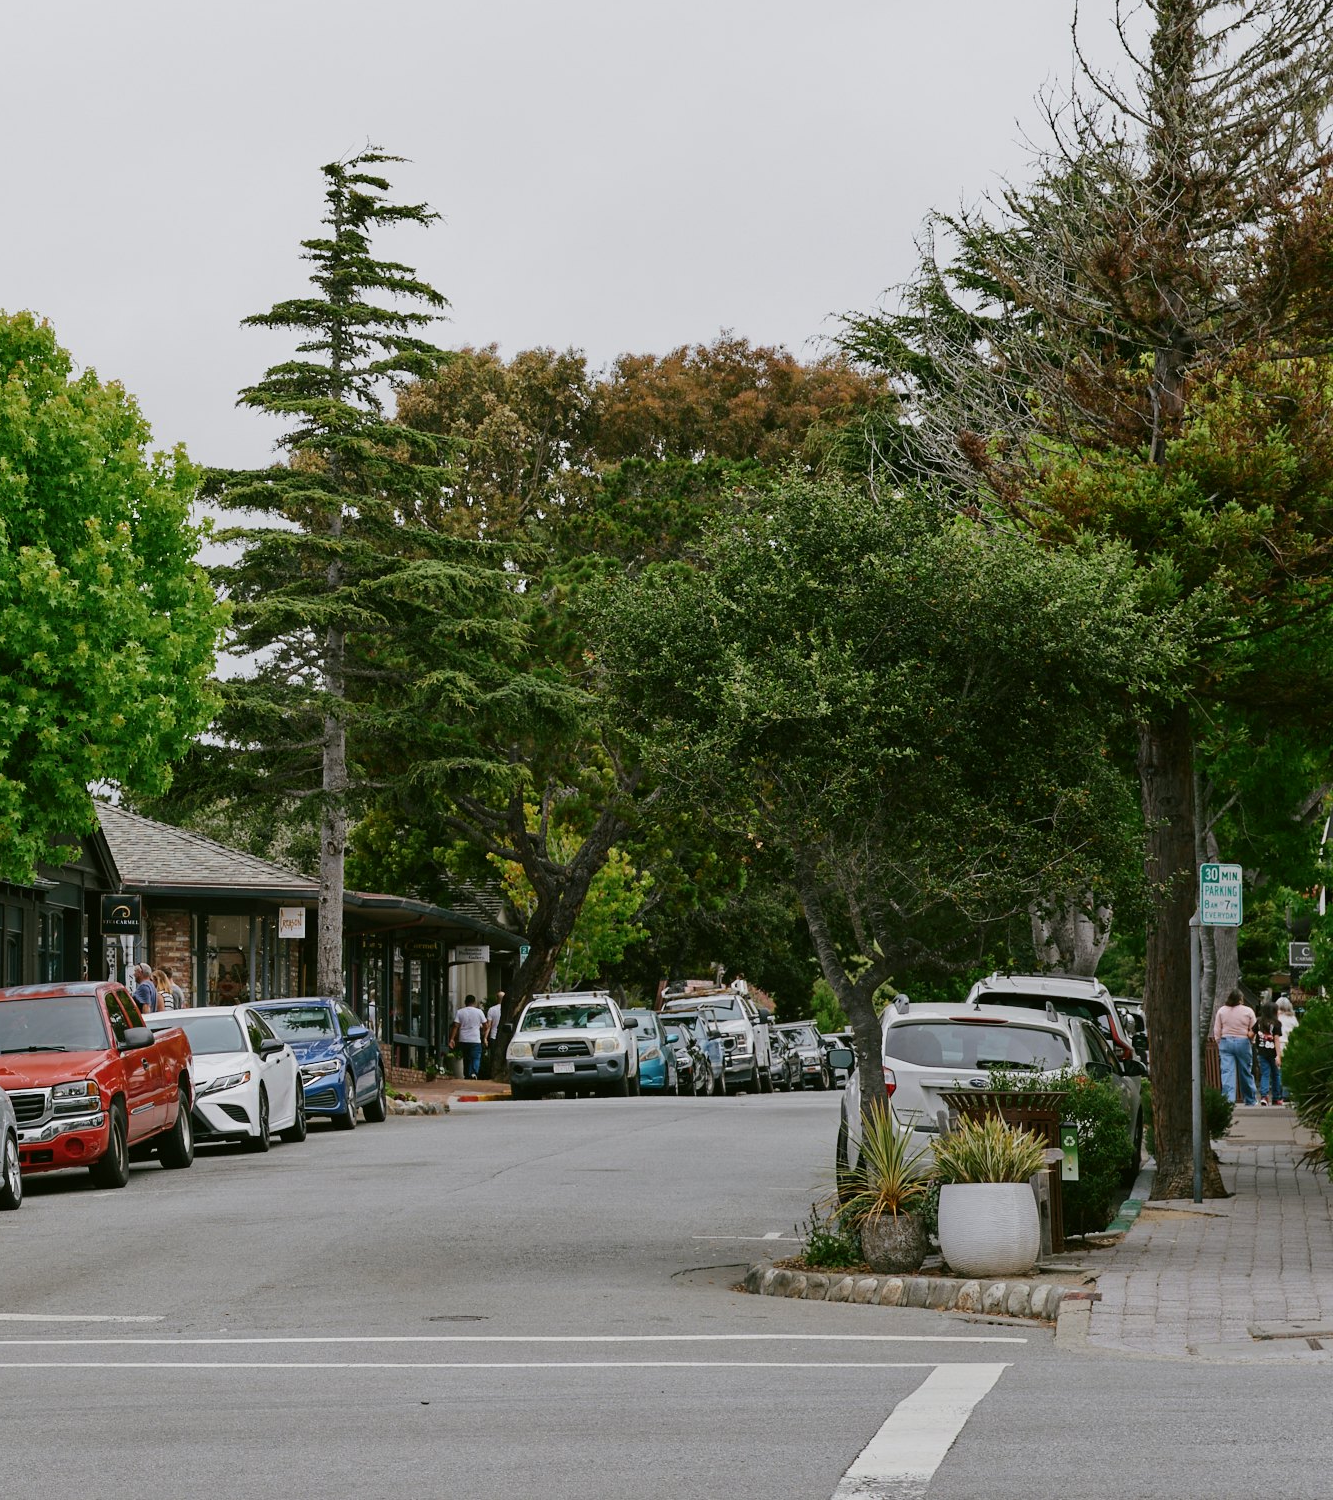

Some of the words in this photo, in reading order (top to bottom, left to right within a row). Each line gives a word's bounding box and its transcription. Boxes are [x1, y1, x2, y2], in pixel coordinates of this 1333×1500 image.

[1205, 867, 1218, 880] 30
[1205, 886, 1237, 897] PARKING
[1205, 911, 1237, 919] EVERYDAY
